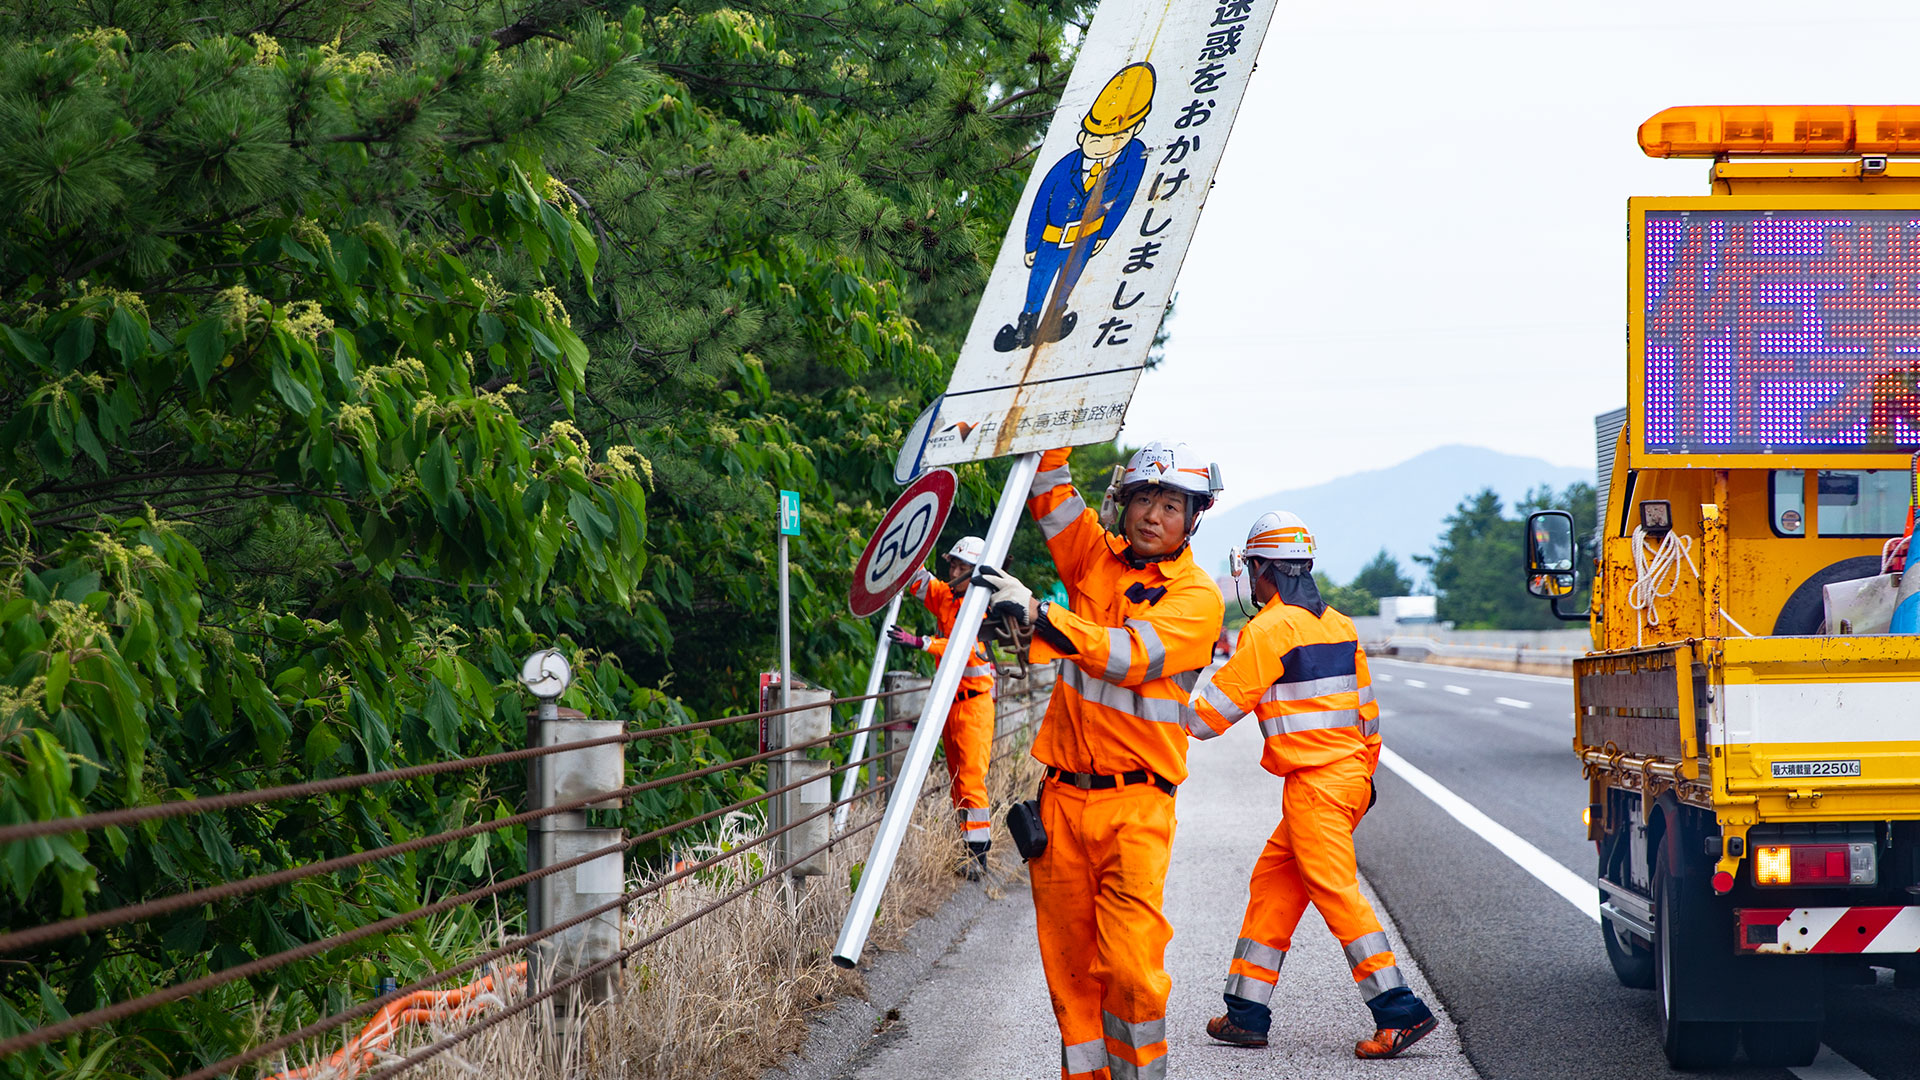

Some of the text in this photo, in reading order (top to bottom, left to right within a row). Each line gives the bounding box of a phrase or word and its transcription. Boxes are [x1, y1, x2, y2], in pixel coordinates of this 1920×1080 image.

[1092, 0, 1255, 347] 迷惑をおかけしました
[927, 434, 955, 444] NEXCO
[979, 402, 1126, 437] 中本高速道路(株)
[872, 503, 931, 582] 50
